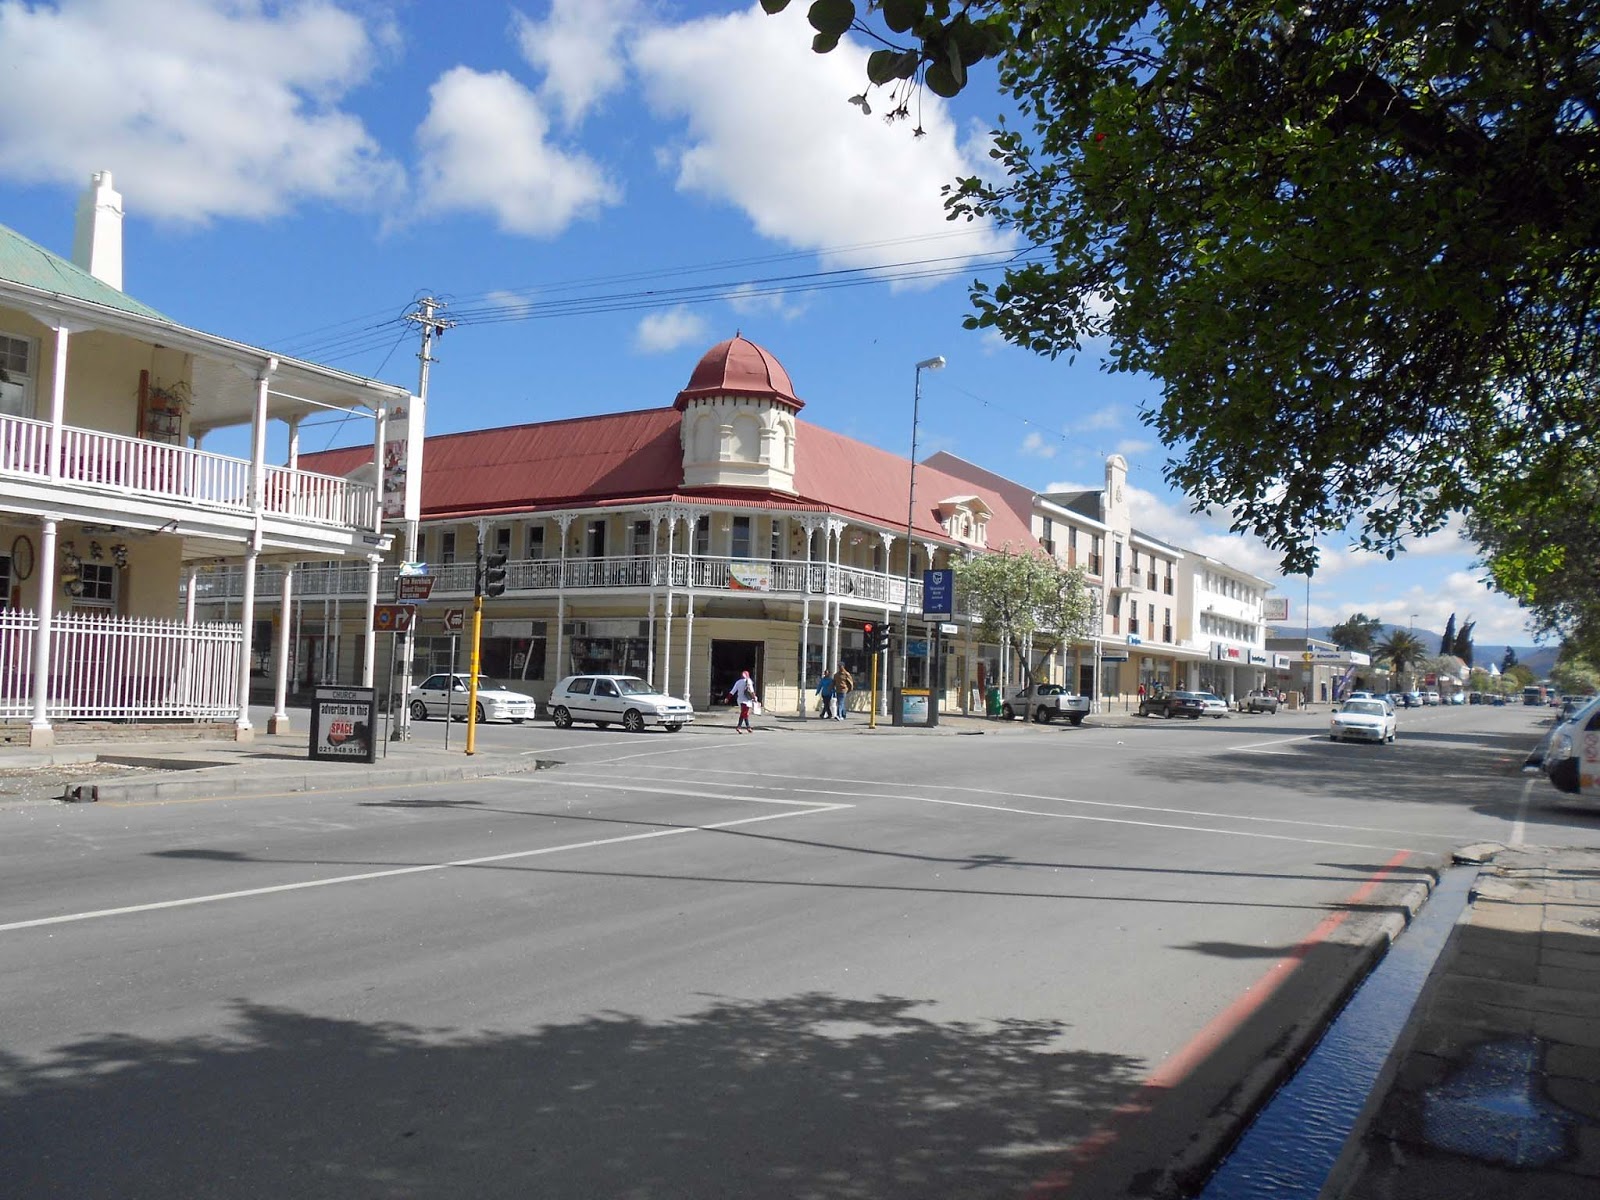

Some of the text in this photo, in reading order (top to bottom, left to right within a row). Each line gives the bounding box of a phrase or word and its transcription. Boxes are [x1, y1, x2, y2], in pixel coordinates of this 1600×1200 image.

[332, 691, 357, 700] CHURCH
[321, 704, 368, 716] advertise in this
[331, 722, 353, 734] SPACE
